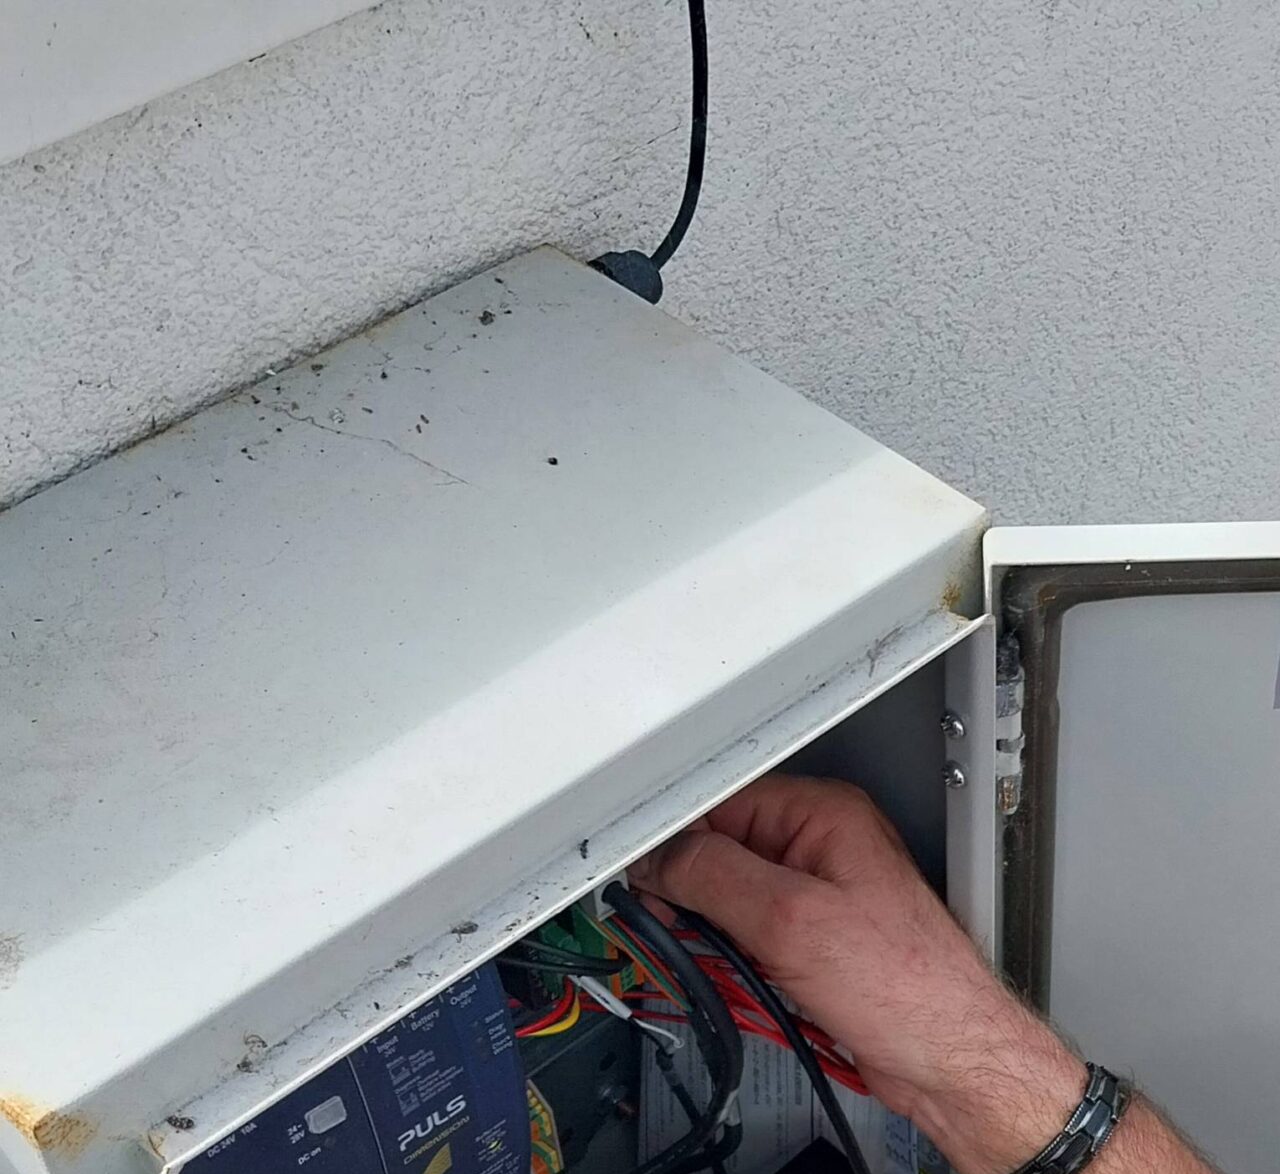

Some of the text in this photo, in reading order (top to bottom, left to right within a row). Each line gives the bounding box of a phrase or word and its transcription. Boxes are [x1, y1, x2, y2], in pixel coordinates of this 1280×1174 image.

[450, 984, 477, 1005] Output
[410, 1010, 440, 1031] Battery
[376, 1035, 399, 1053] Input
[397, 1094, 467, 1151] PULS
[403, 1115, 470, 1165] DIMENSION
[207, 1147, 221, 1158] DC
[298, 1154, 310, 1165] DC
